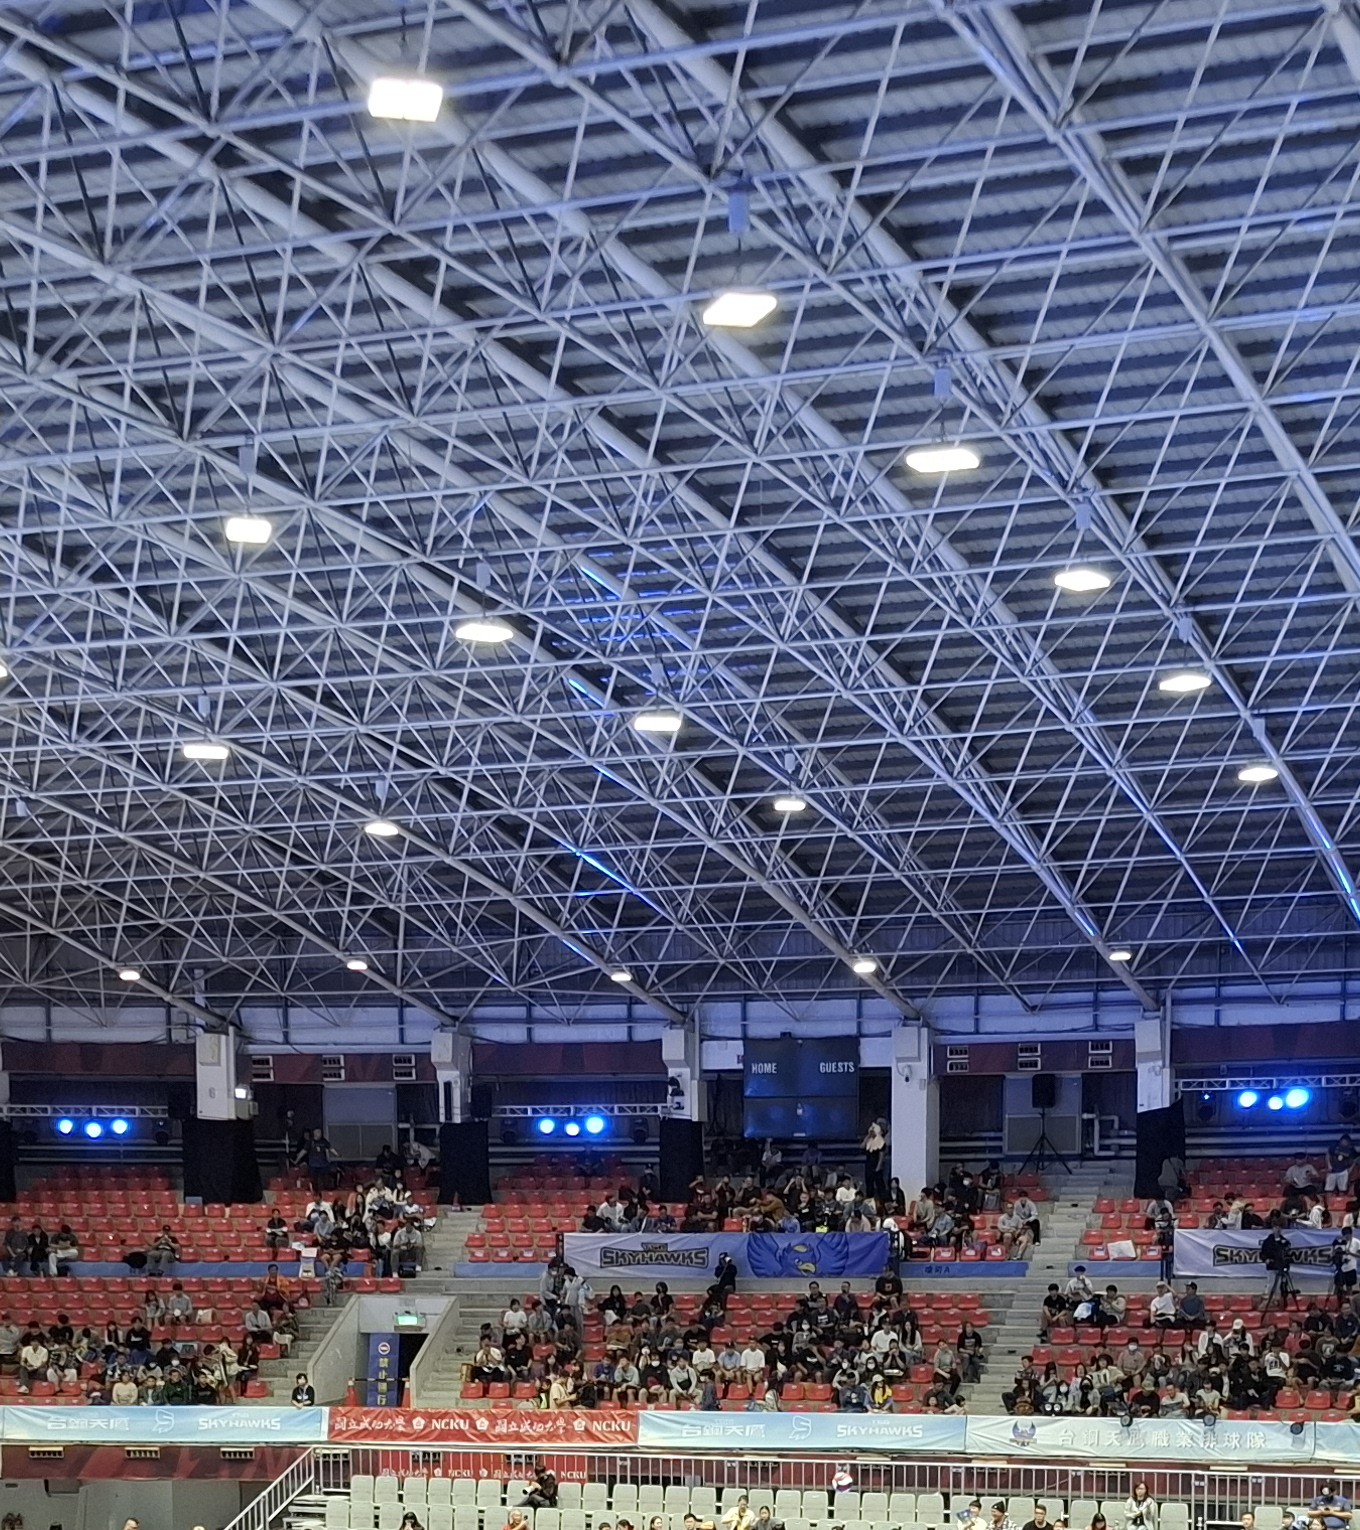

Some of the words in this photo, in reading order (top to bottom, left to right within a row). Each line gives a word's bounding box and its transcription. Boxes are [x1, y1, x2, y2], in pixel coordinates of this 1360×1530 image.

[751, 1063, 777, 1074] HOME
[820, 1062, 855, 1073] GUESTS
[601, 1248, 708, 1268] SKYHAWKS
[1214, 1245, 1332, 1267] SKYWKS
[198, 1417, 281, 1431] SKYHAWKS
[431, 1418, 470, 1431] NCKU
[592, 1419, 631, 1432] NCKU
[836, 1424, 923, 1438] SKYHAWKS
